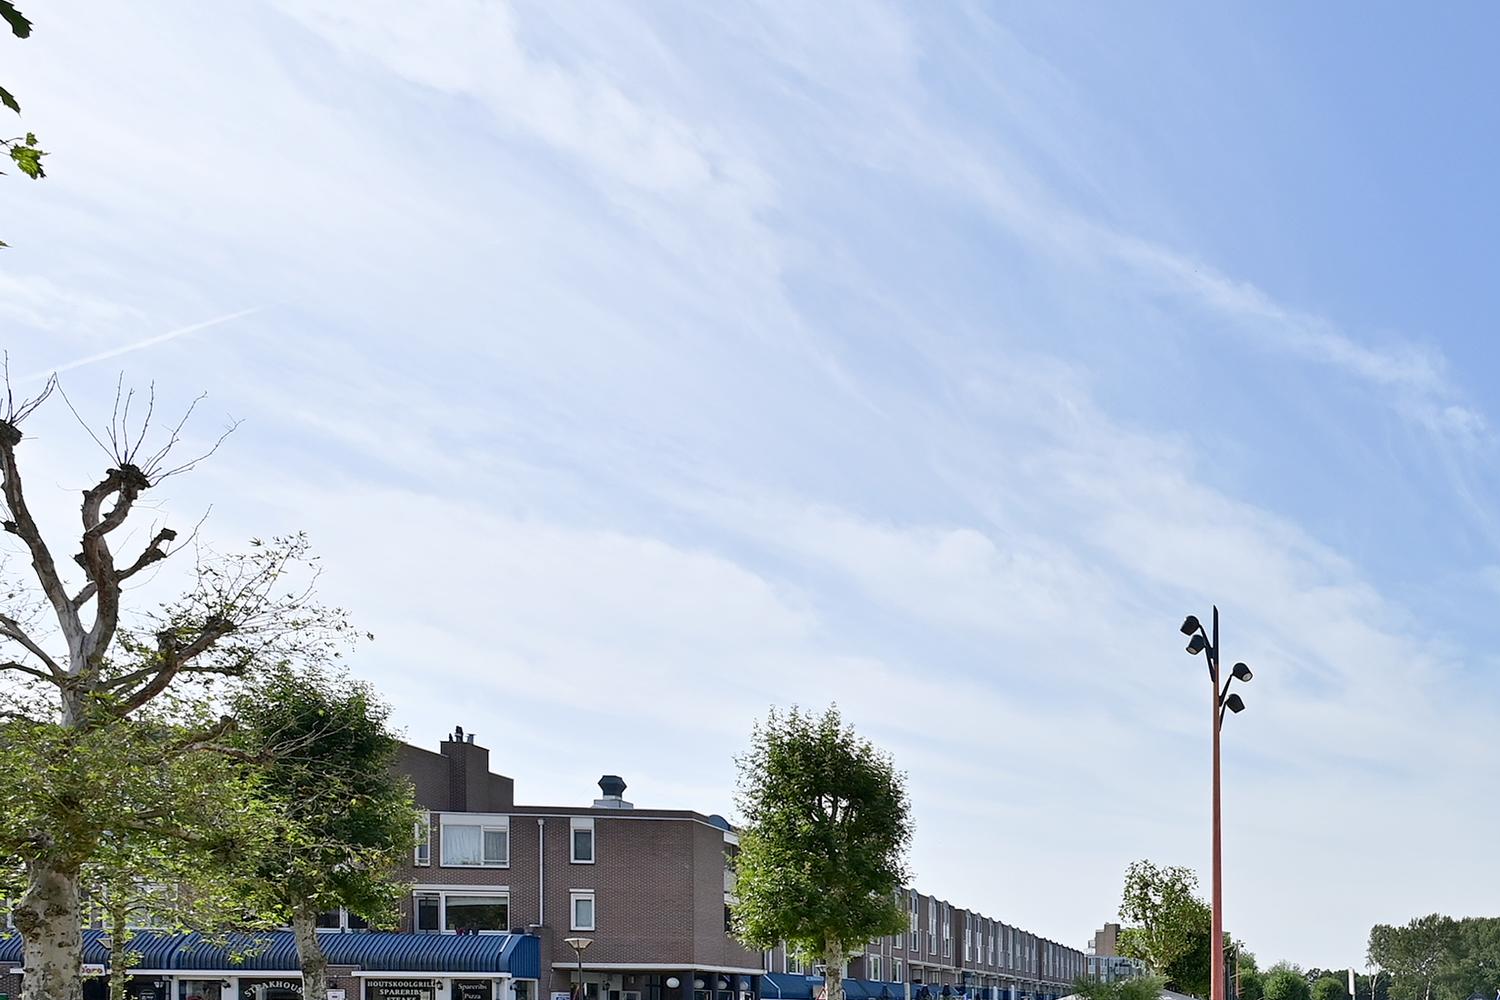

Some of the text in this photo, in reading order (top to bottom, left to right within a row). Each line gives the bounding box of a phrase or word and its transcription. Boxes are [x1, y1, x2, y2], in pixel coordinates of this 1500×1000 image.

[244, 981, 304, 998] STEAKHOUS
[379, 988, 423, 996] SPARERIBS
[458, 983, 488, 992] Spareribs
